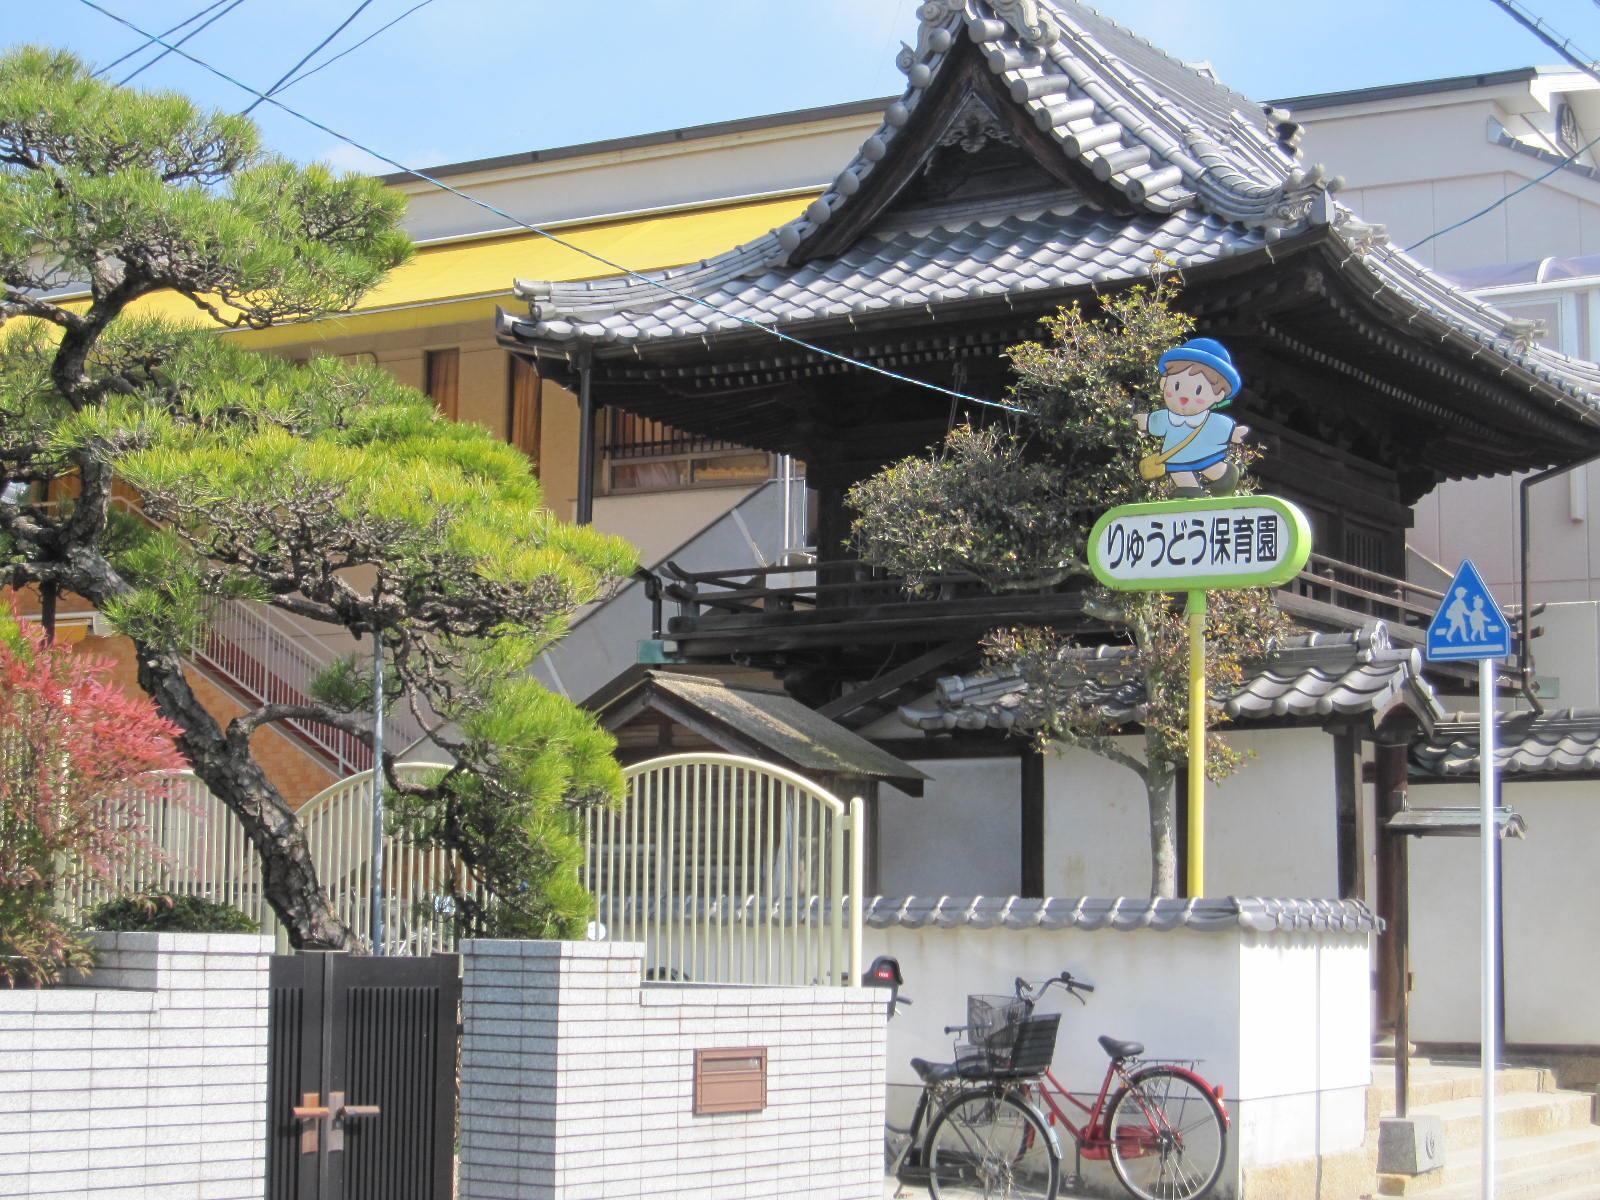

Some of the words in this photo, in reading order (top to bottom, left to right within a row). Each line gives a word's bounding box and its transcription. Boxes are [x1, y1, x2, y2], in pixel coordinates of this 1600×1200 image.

[1107, 515, 1278, 570] りゅうどう保育園
